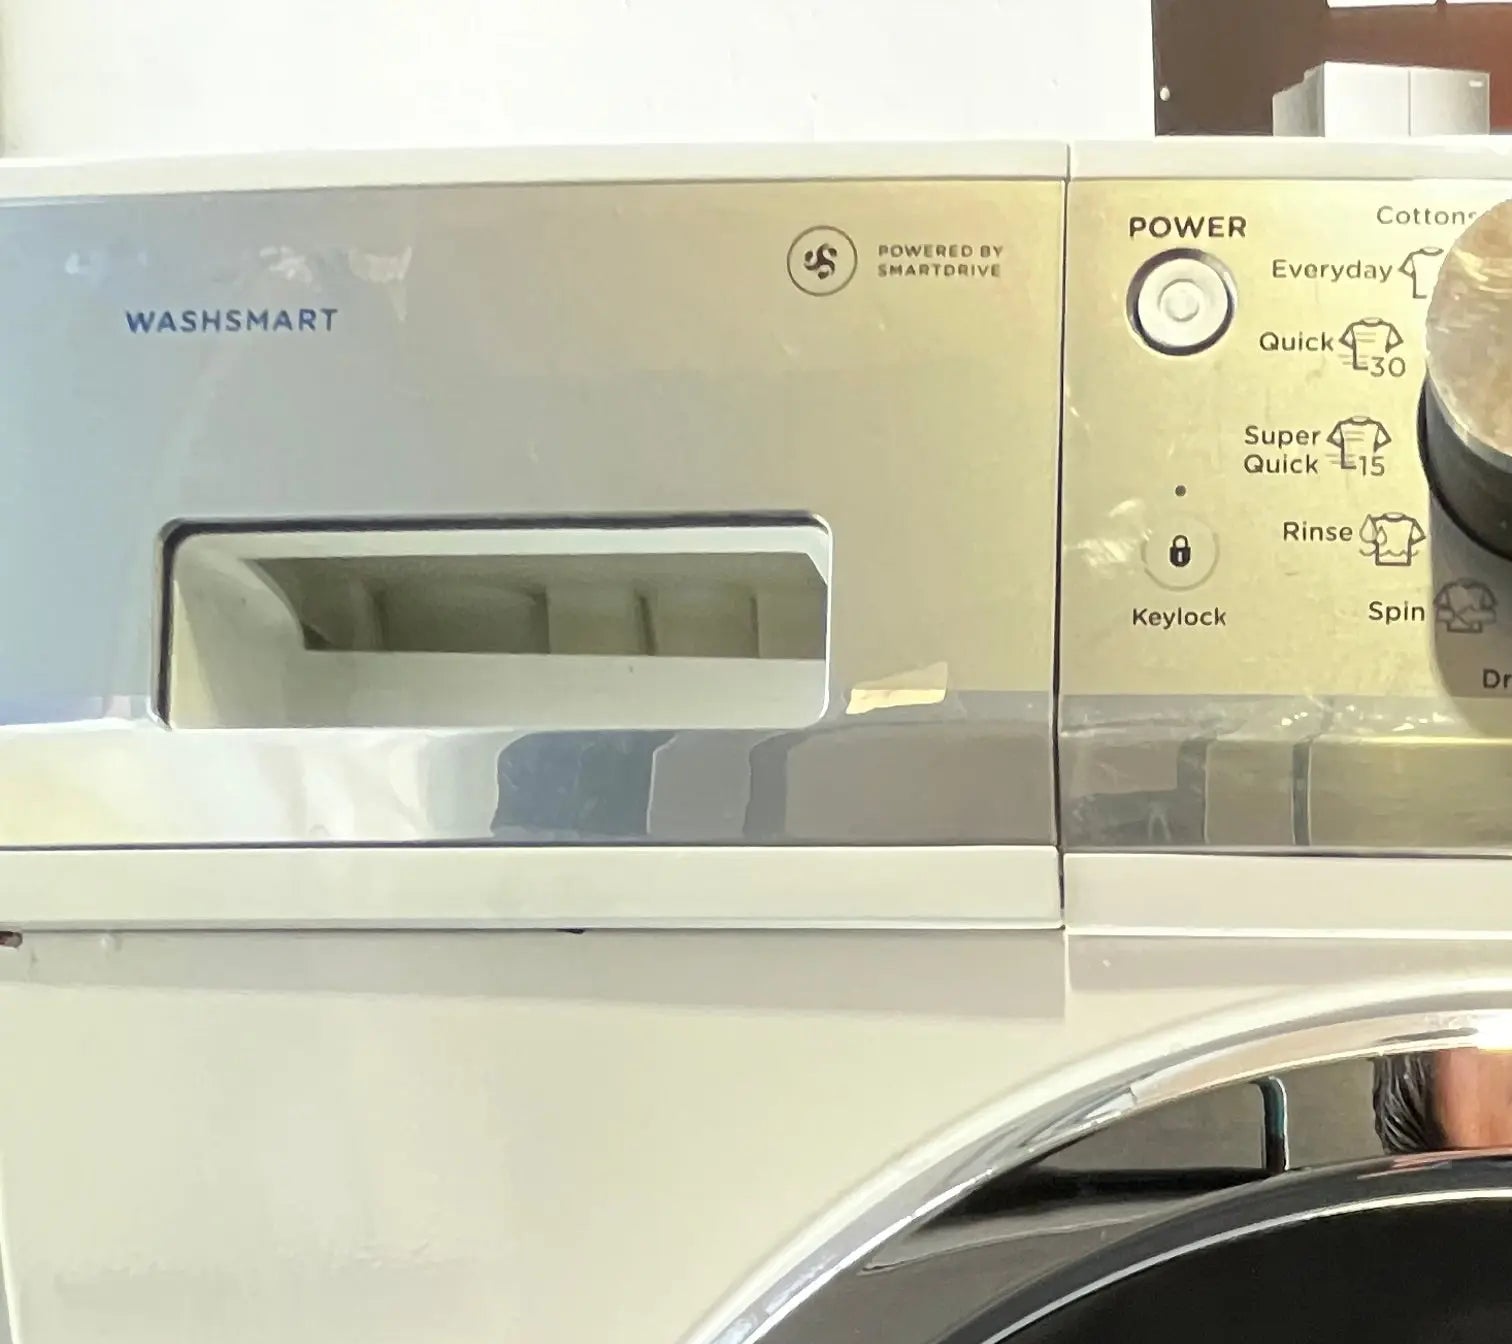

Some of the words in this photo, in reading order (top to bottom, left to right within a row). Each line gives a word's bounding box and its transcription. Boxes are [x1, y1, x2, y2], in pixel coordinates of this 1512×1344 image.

[1129, 216, 1248, 239] POWER
[878, 244, 974, 258] POWERED
[980, 244, 1004, 258] BY
[878, 263, 1001, 278] SMARTDRIVE
[1271, 258, 1394, 284] Everyday
[125, 308, 338, 334] WASHSMART
[1259, 330, 1335, 353] Quick
[1369, 356, 1407, 378] 30
[1243, 424, 1322, 448] Super
[1243, 453, 1319, 475] Quick
[1282, 520, 1354, 543] Rinse
[1131, 606, 1227, 630] Keylock
[1368, 600, 1426, 625] Spin
